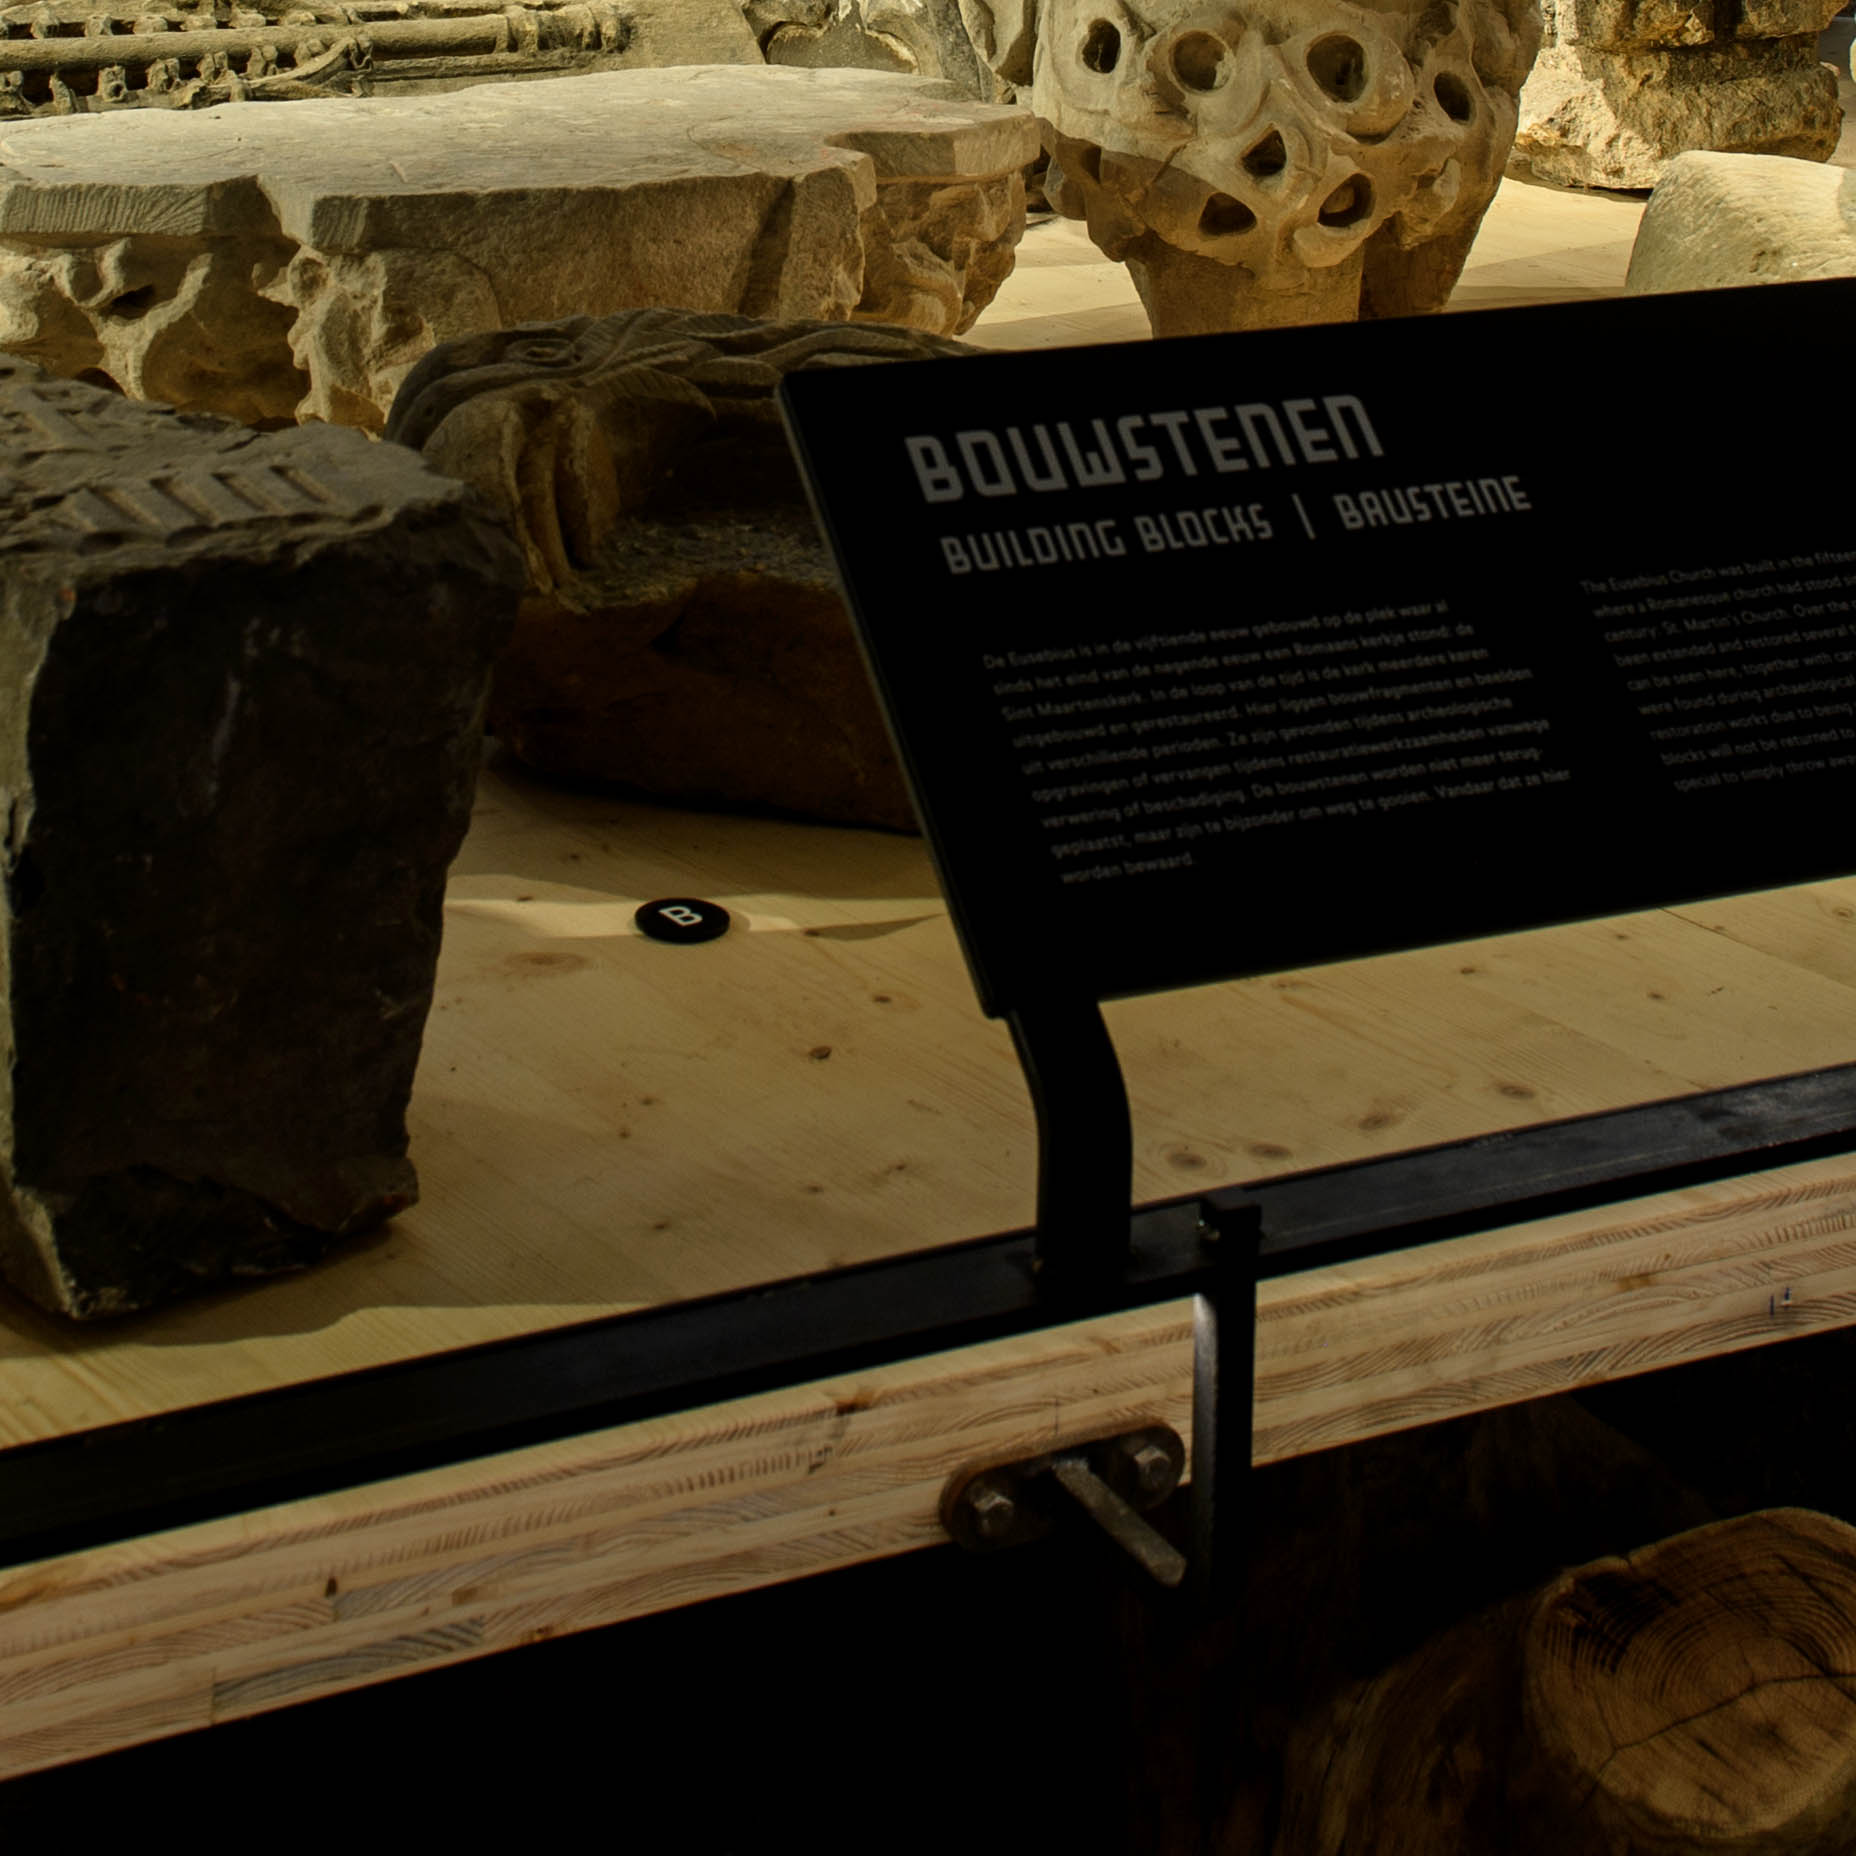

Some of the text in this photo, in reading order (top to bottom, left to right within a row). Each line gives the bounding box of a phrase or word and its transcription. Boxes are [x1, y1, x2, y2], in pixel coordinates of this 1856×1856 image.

[904, 394, 1384, 502] BOUWSTENEN
[940, 475, 1532, 574] BUILDING BLOCKS BAUSTEINE
[658, 906, 704, 927] B
